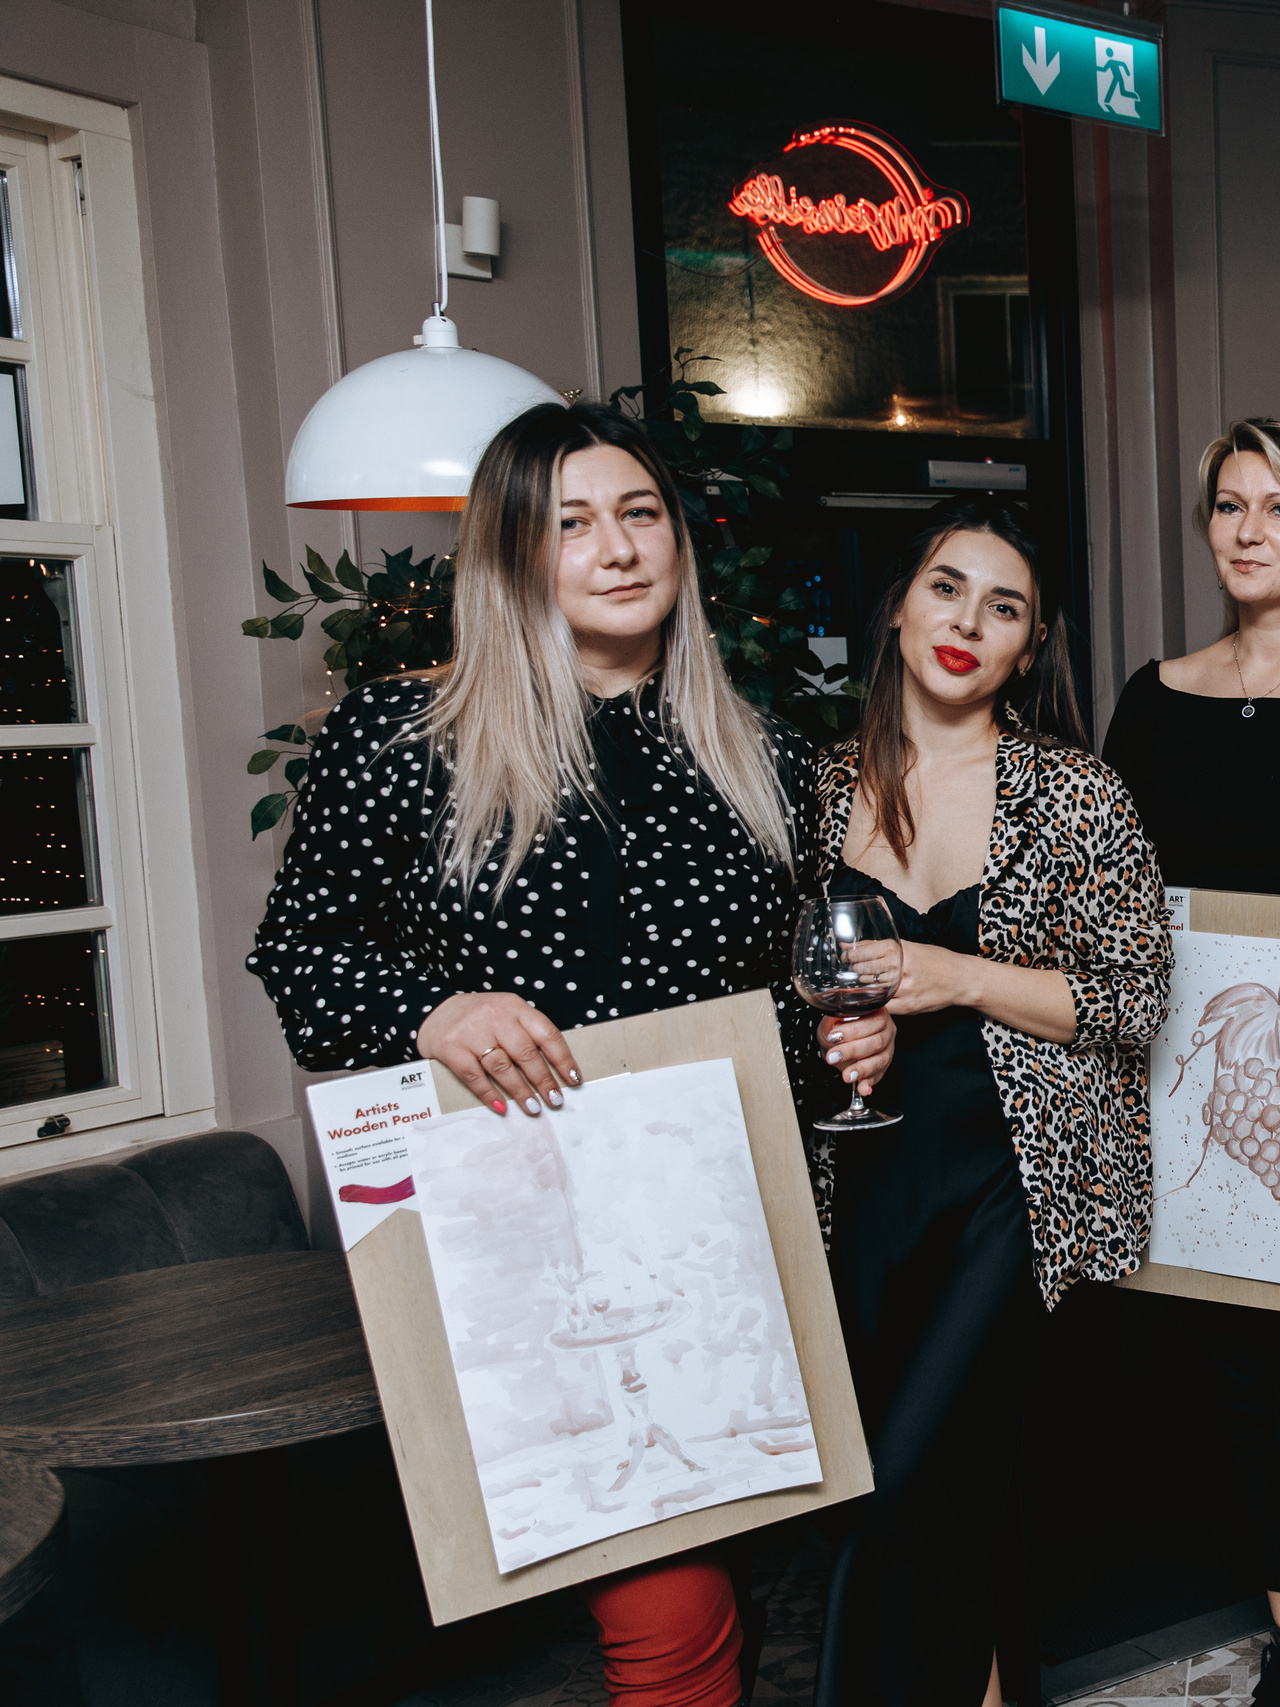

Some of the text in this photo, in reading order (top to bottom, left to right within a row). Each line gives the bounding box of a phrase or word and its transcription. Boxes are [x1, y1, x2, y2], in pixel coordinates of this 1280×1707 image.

[1166, 923, 1184, 931] anel
[400, 1072, 424, 1085] ART
[355, 1101, 400, 1119] Artists
[328, 1107, 432, 1140] Wooden Panel
